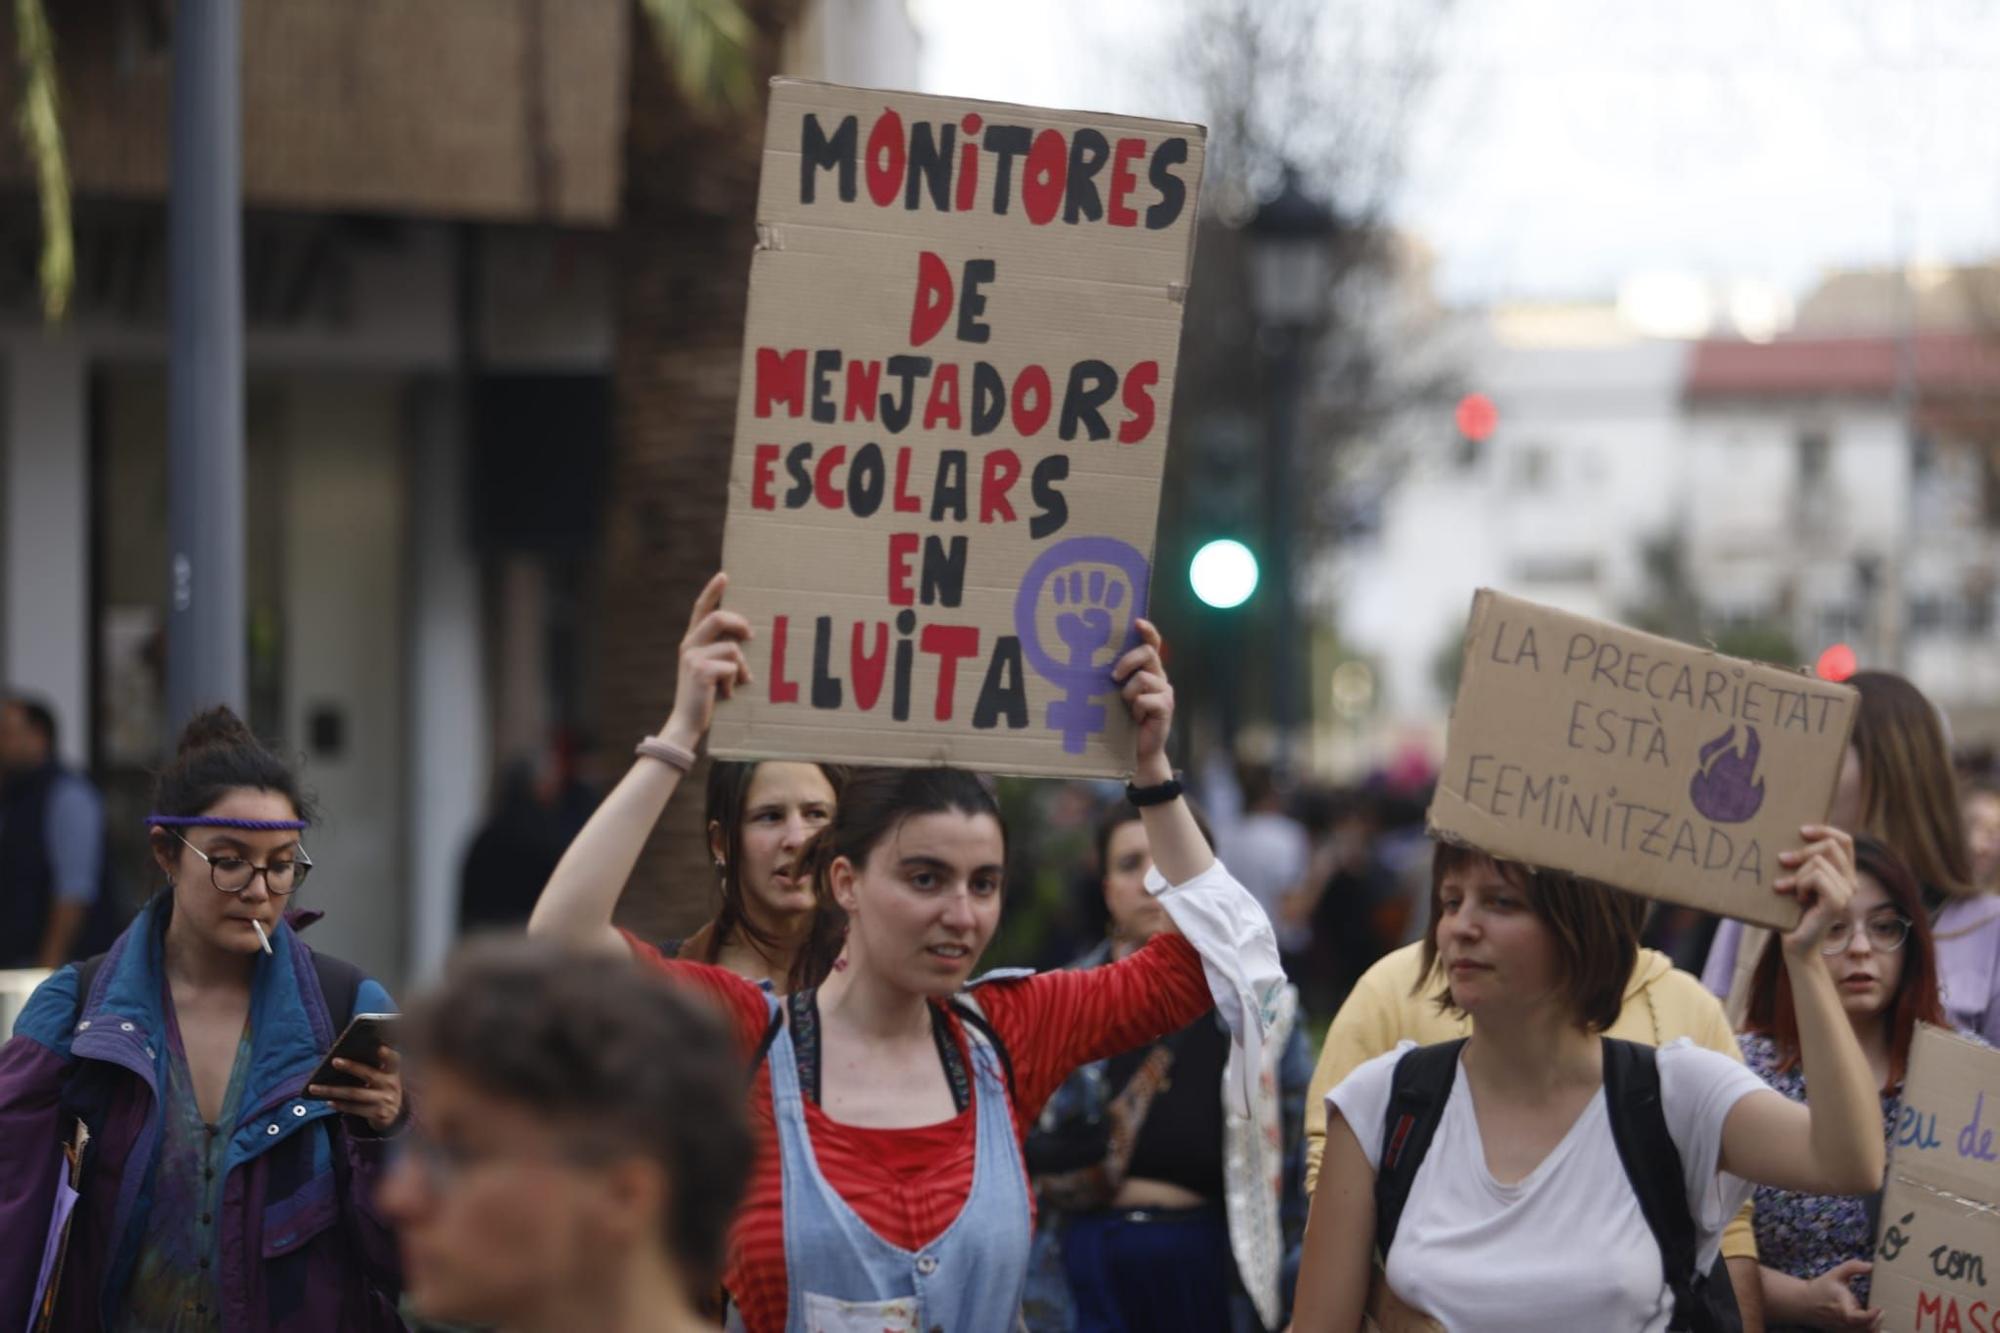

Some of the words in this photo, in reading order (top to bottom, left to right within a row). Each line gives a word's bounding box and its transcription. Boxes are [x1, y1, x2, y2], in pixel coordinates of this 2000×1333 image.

[909, 251, 996, 348] DE
[755, 347, 1160, 445] MENJADORS
[751, 440, 1071, 540] ESCOLARS
[888, 533, 968, 607] EN
[1491, 621, 1540, 672] LA
[1567, 701, 1670, 768] ESTÀ
[1957, 1090, 1998, 1161] de
[1929, 1245, 1986, 1286] com
